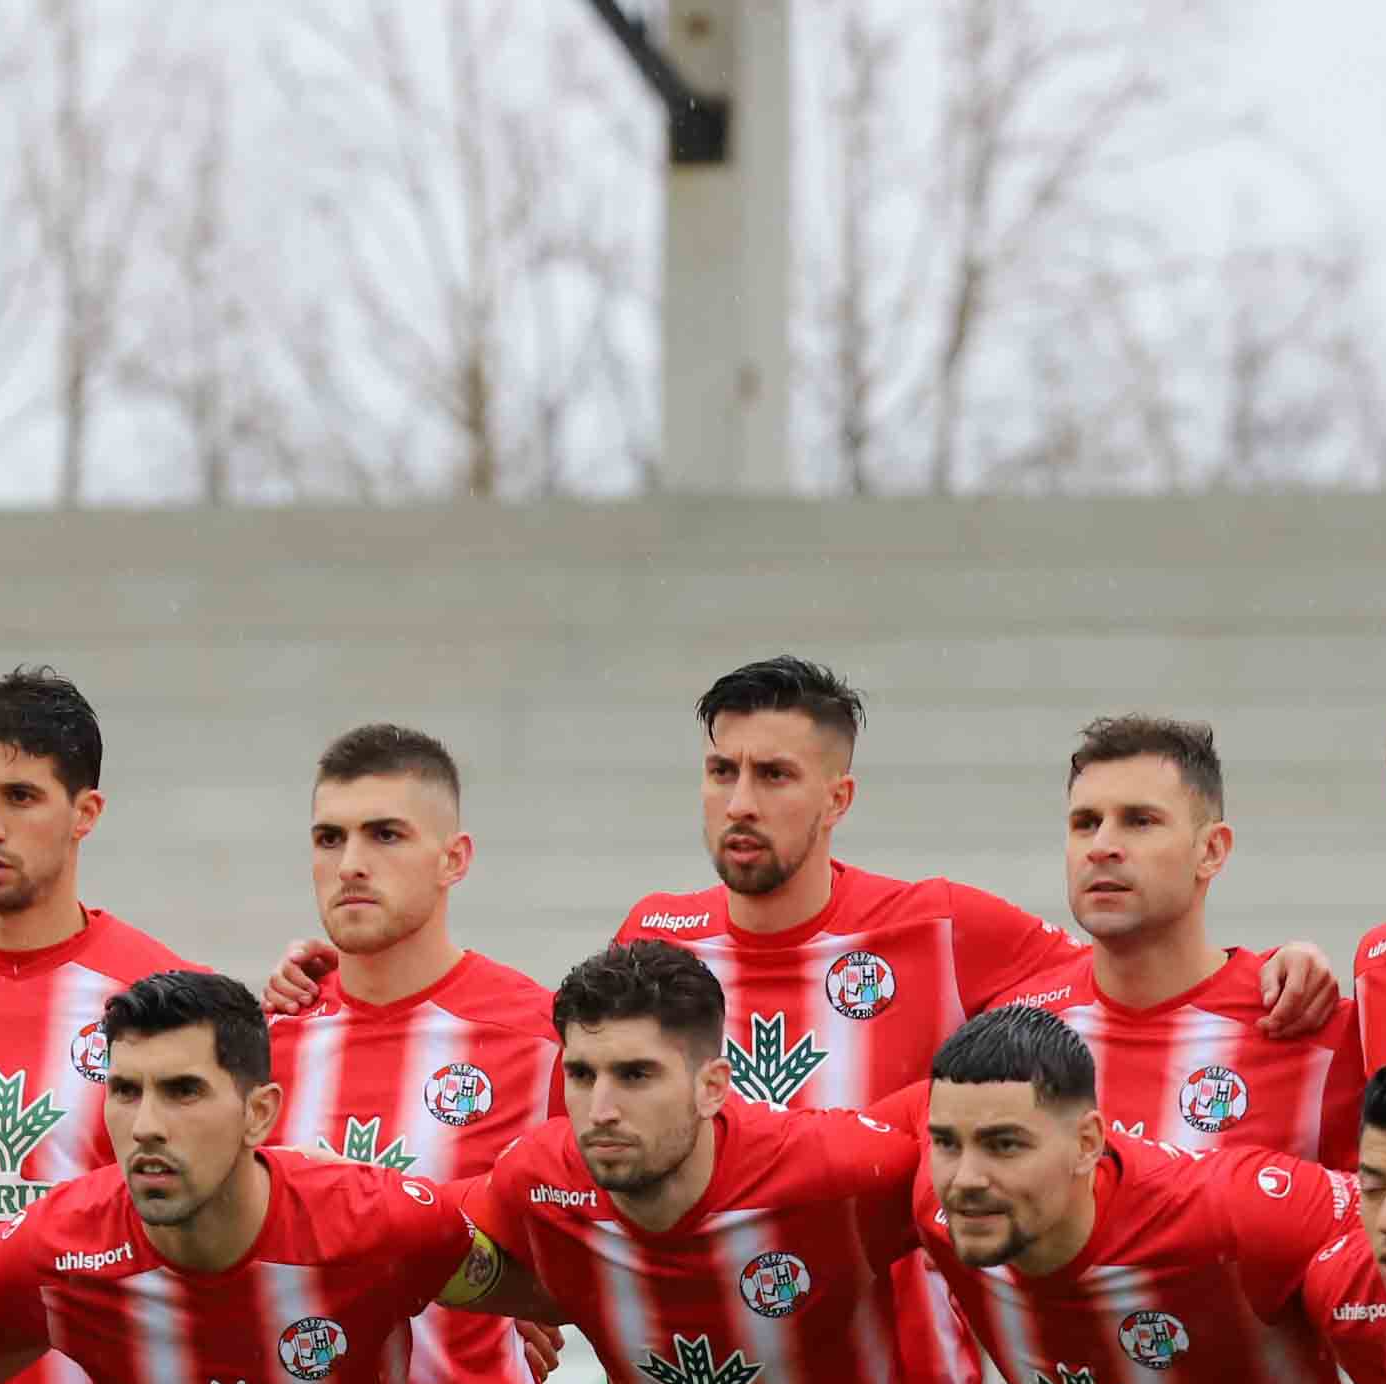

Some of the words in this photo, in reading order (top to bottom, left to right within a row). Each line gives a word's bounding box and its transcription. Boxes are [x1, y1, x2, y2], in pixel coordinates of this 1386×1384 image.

[641, 912, 710, 932] uhlsport
[531, 1185, 598, 1207] uhlsport
[55, 1242, 133, 1271] uhlsport
